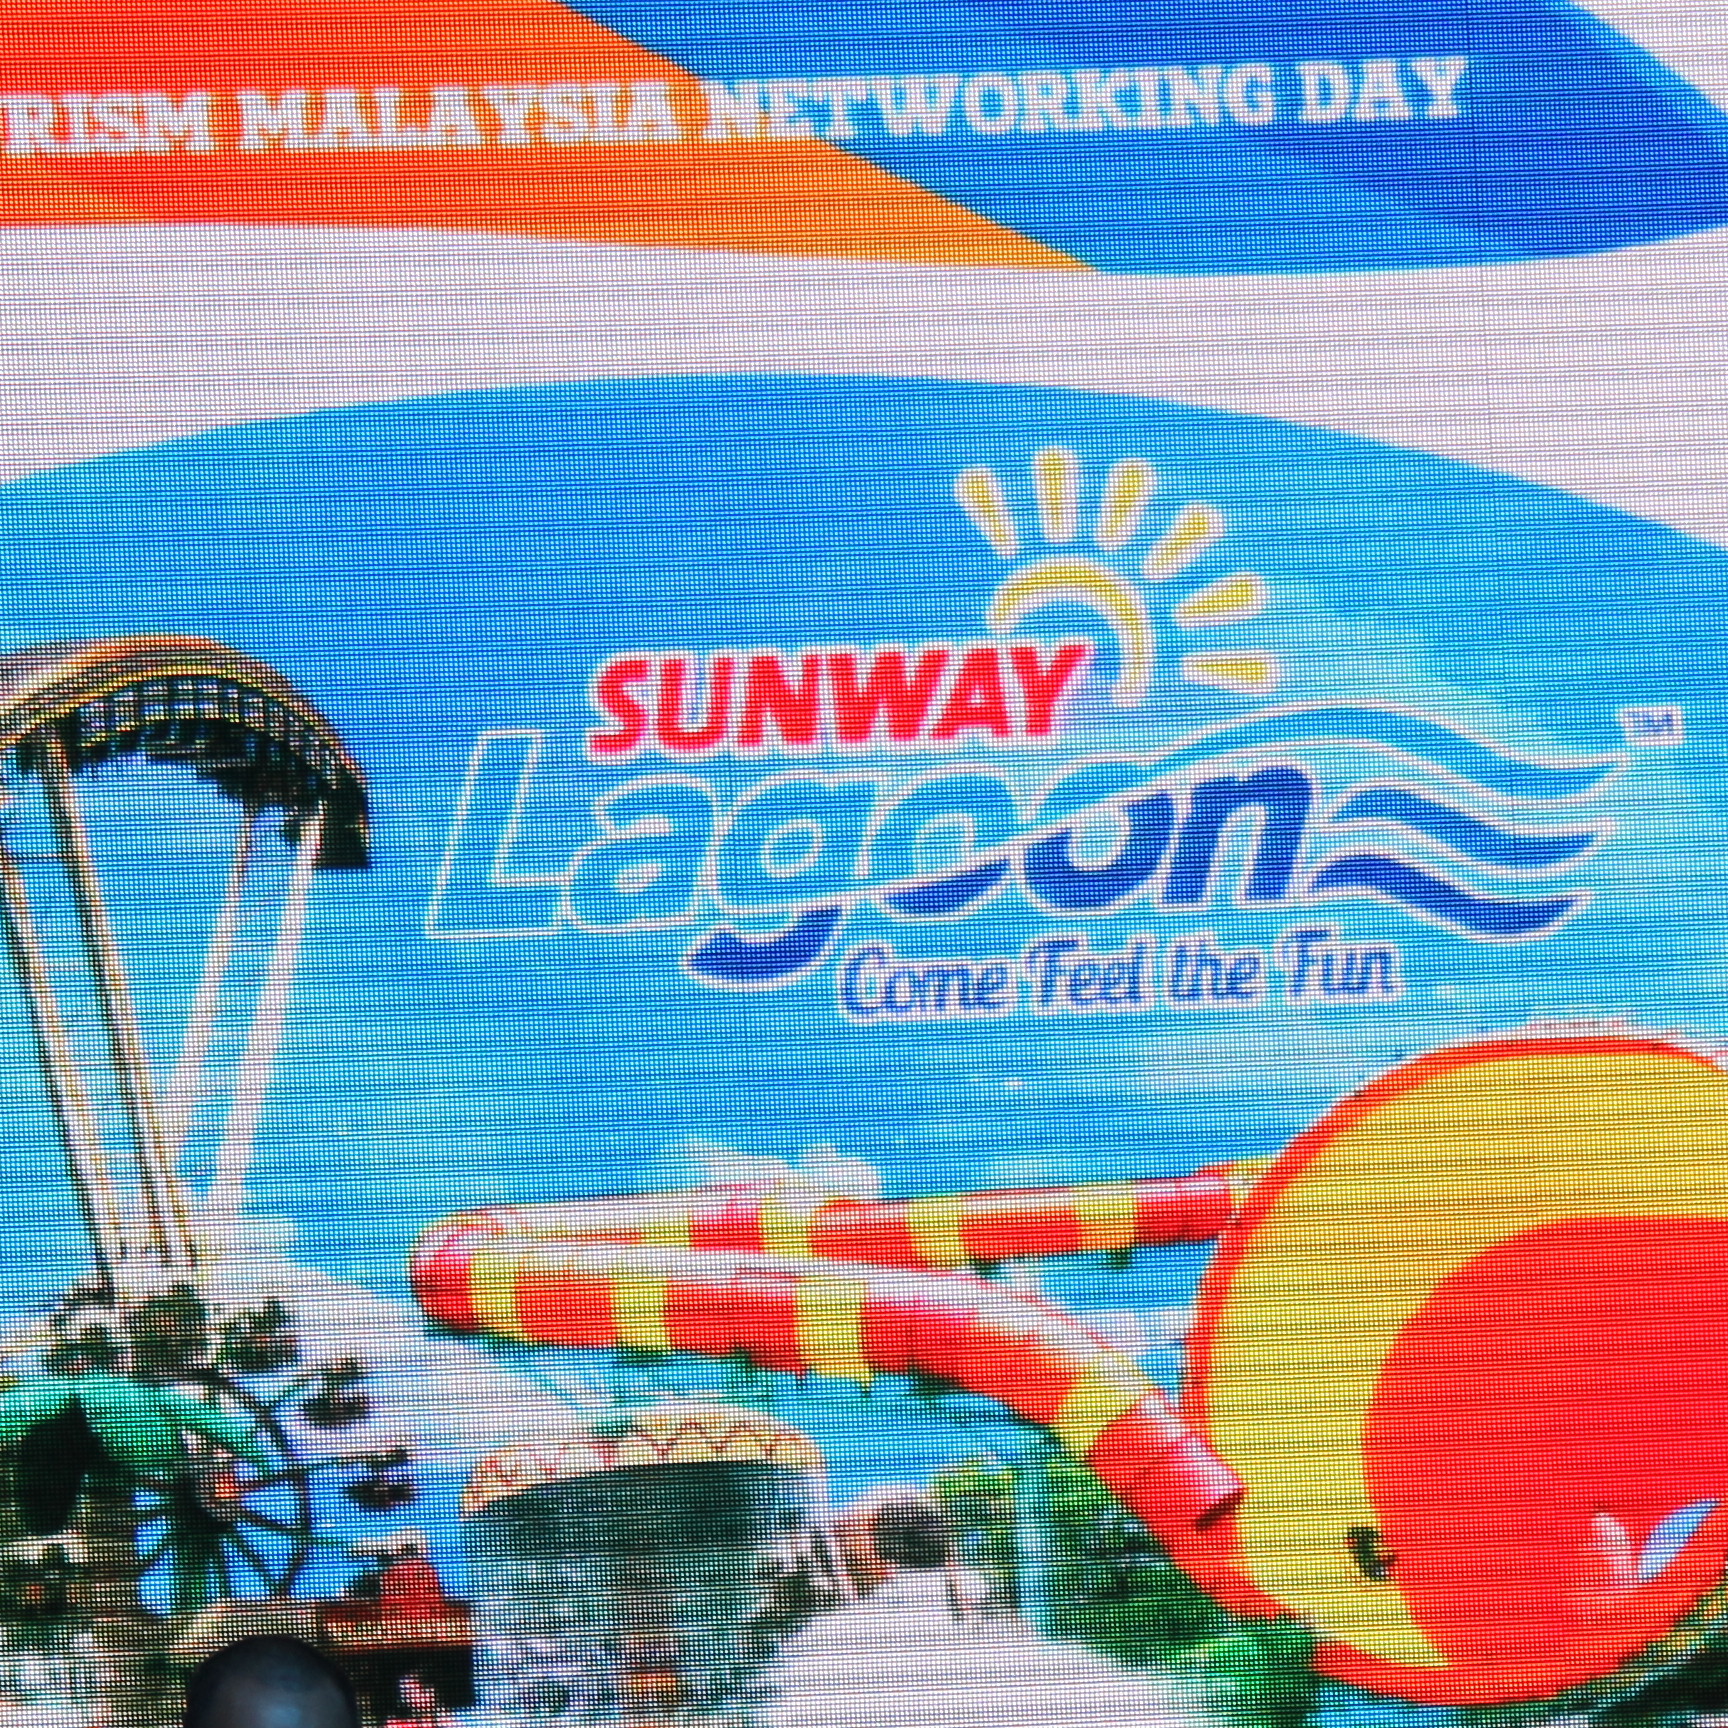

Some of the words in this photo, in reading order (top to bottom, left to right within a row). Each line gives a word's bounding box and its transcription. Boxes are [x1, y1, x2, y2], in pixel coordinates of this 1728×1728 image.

[236, 80, 671, 151] MALAYSIA
[703, 60, 1274, 143] NETWORKING
[1298, 54, 1469, 125] DAY
[590, 641, 1094, 755] SUNWAY
[426, 728, 1317, 988] Lagoon
[842, 945, 1012, 1016] Come
[1026, 937, 1149, 1005] Feel
[1167, 937, 1263, 1003] the
[1278, 927, 1401, 998] Fun
